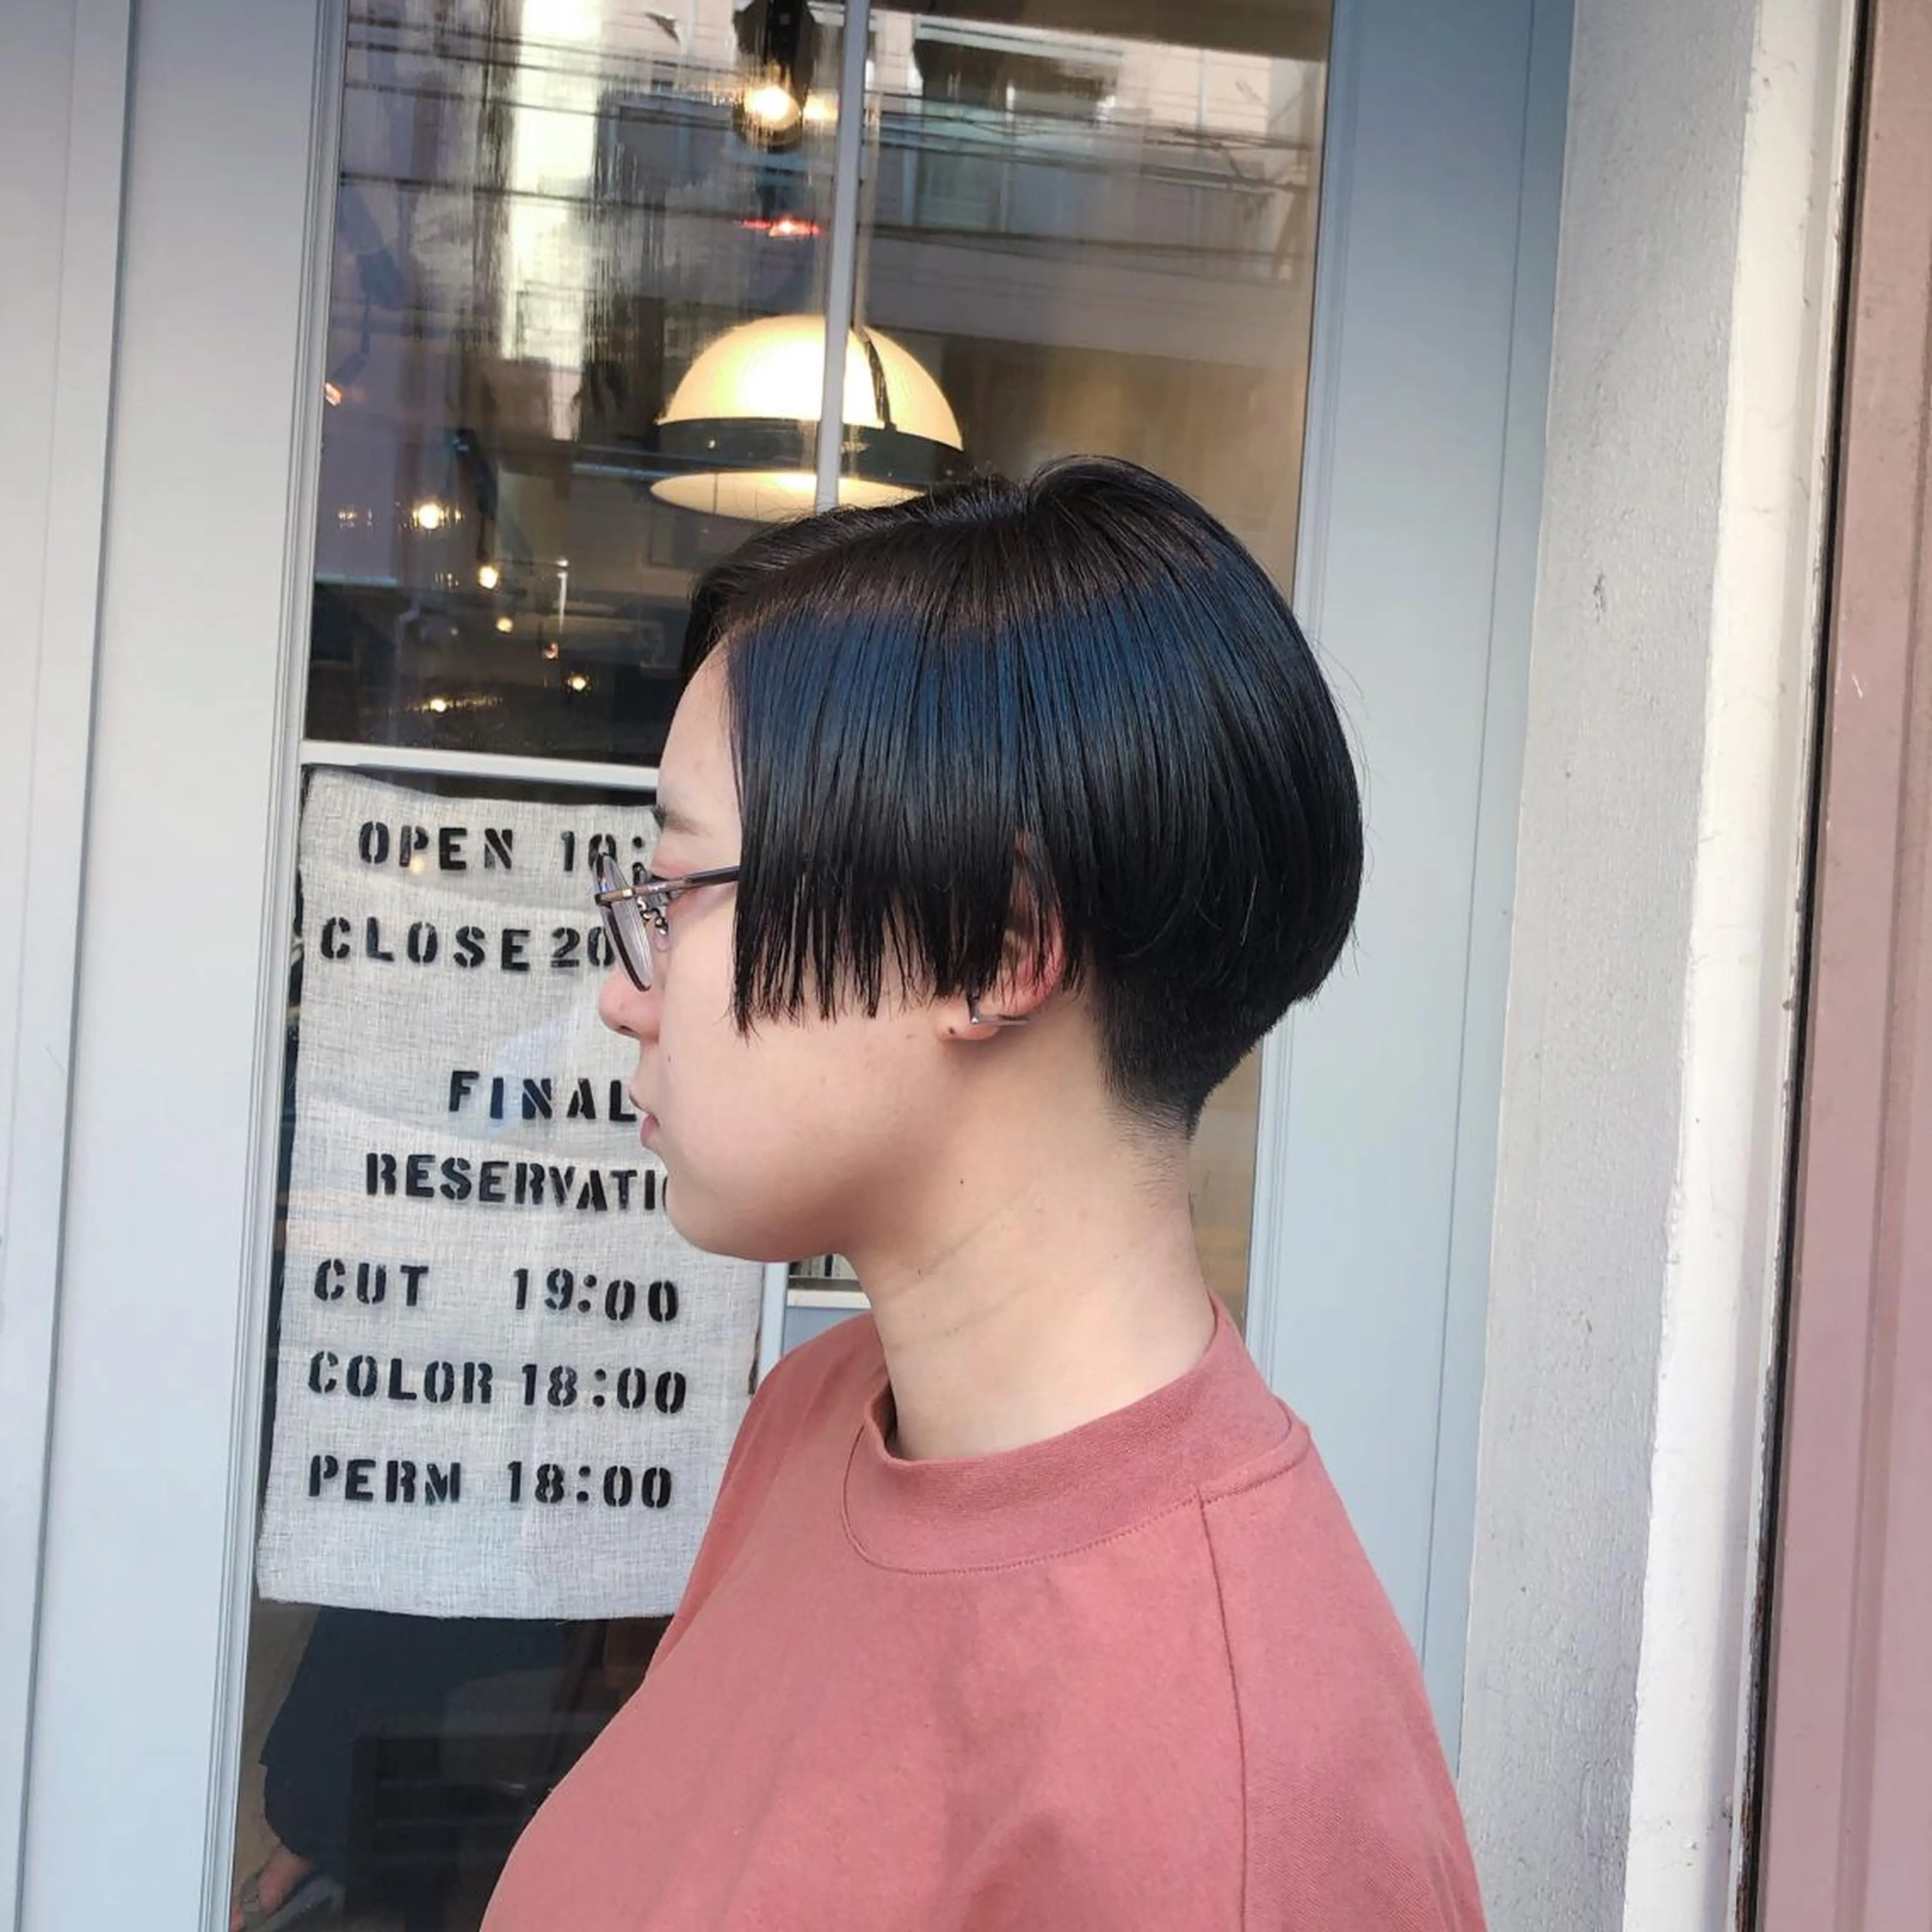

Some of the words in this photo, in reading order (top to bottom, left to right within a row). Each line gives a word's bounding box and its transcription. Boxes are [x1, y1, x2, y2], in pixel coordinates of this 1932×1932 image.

[359, 821, 513, 871] OPEN
[320, 917, 531, 972] CLOSE
[449, 1070, 637, 1121] FINAL
[366, 1152, 667, 1212] RESERVATI
[314, 1258, 429, 1307] CUT
[513, 1267, 679, 1323] 19:00
[308, 1351, 493, 1404] COLOR
[521, 1363, 686, 1414] 18:00
[308, 1455, 461, 1505] PERM
[507, 1461, 673, 1509] 18:00
